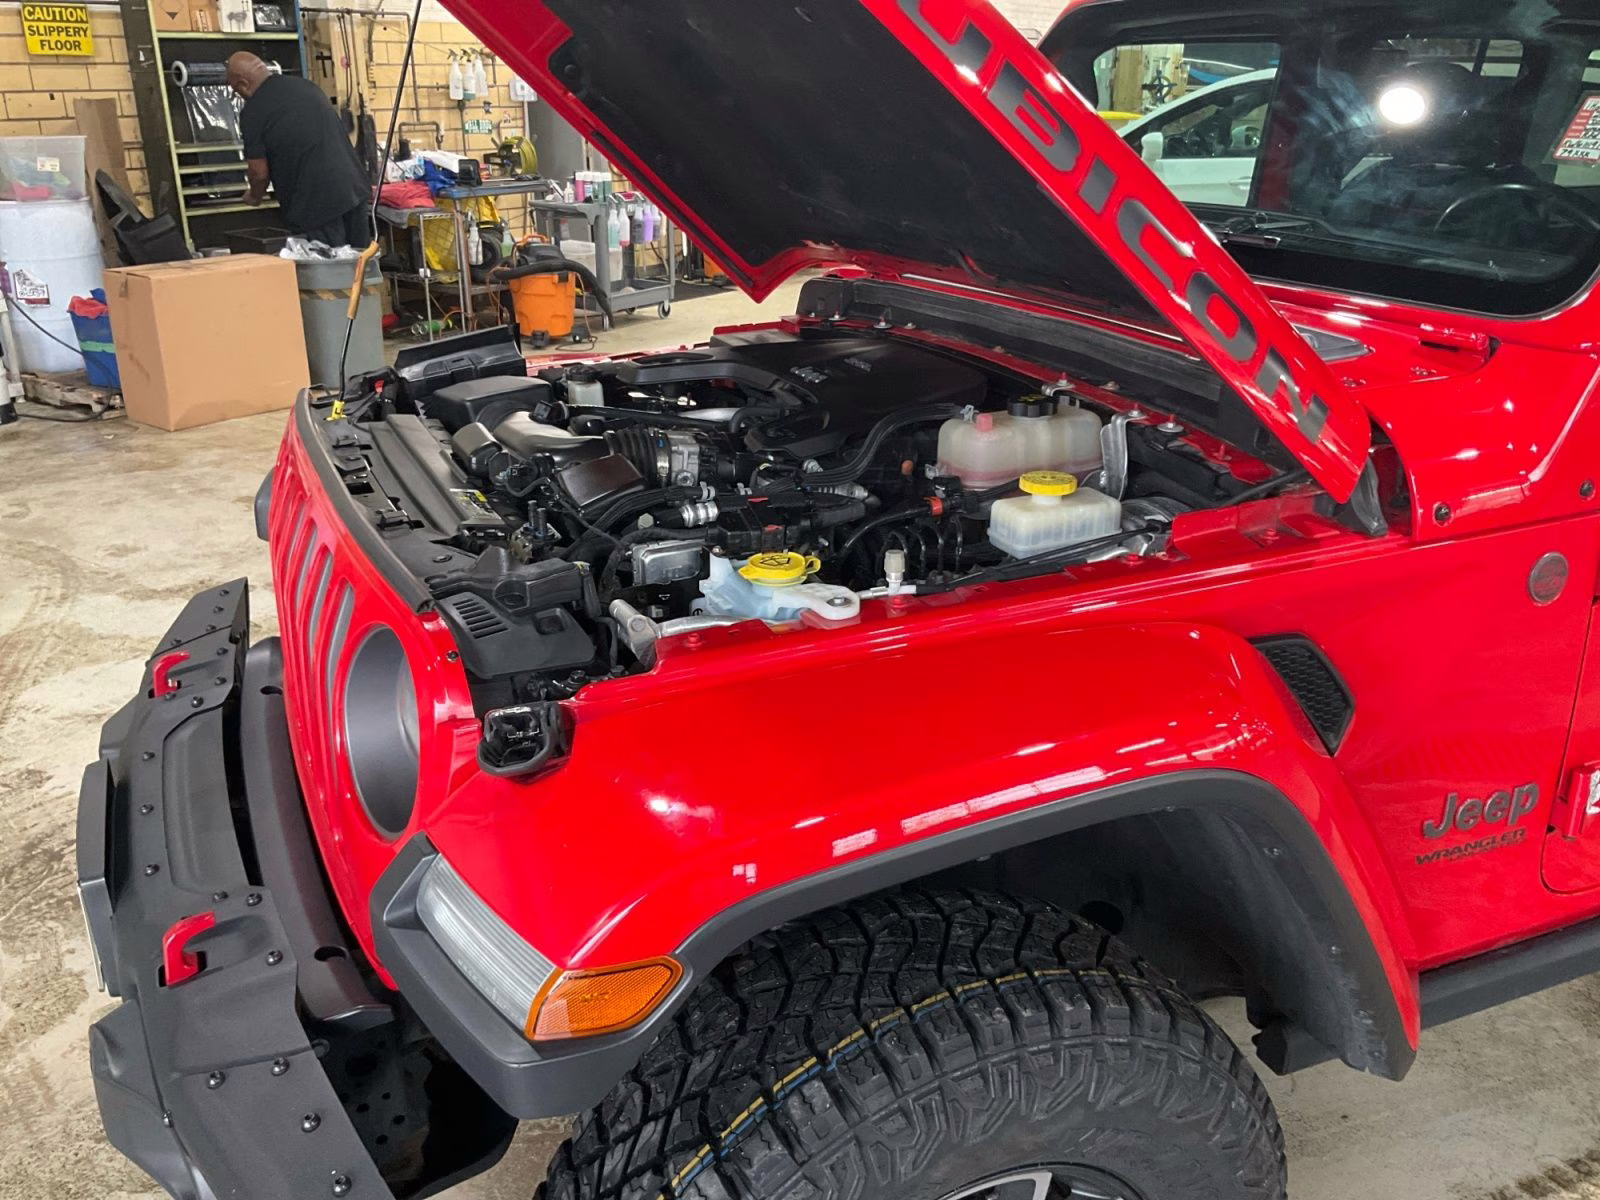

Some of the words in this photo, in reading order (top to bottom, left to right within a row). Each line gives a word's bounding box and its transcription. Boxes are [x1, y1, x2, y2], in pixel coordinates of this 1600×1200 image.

[24, 6, 87, 22] CAUTION
[28, 25, 88, 37] SLIPPERY
[40, 39, 82, 51] FLOOR
[1422, 782, 1540, 839] Jeep
[1415, 827, 1526, 865] WRANGLER
